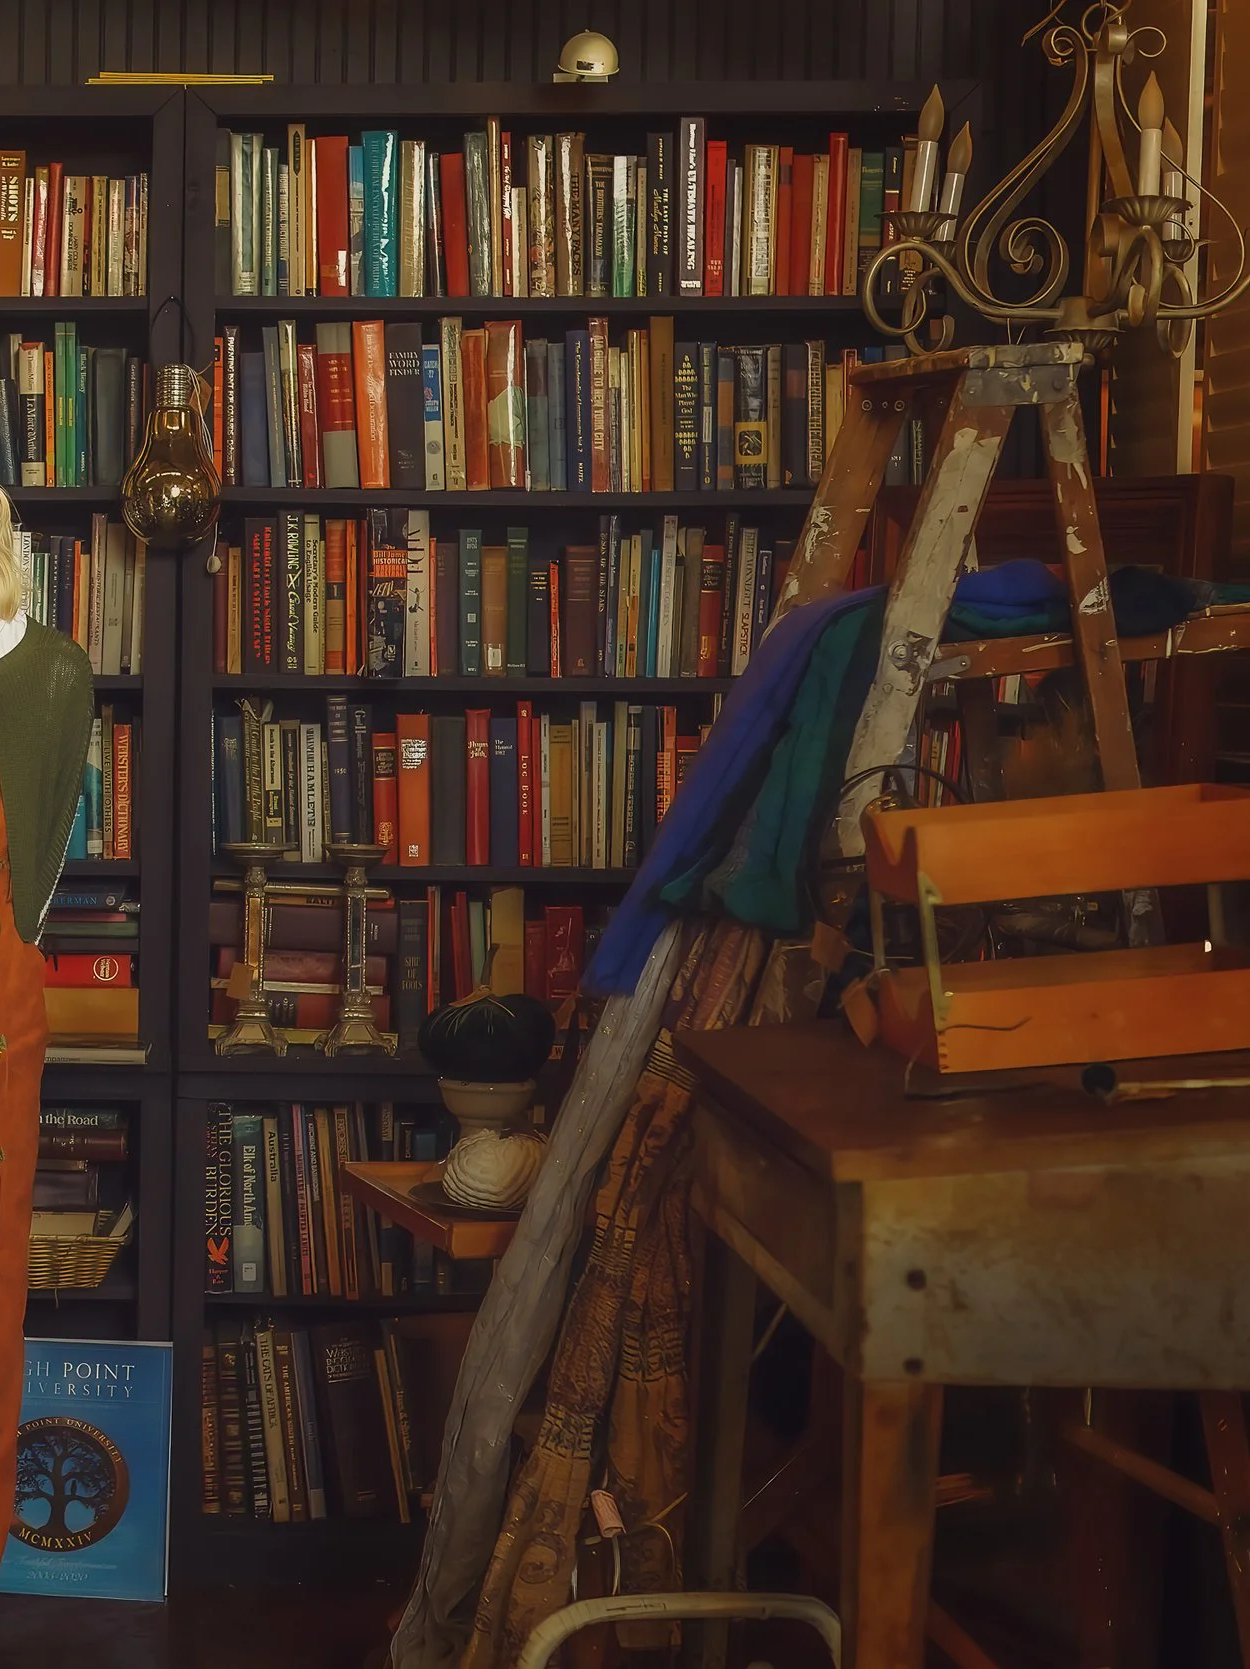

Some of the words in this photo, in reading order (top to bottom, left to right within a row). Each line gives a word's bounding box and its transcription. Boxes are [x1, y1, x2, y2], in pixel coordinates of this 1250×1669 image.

[388, 360, 420, 369] WORD
[389, 368, 420, 377] FINDER
[251, 776, 261, 796] Little
[117, 794, 129, 852] DICTIONARY
[46, 1113, 64, 1125] the
[68, 1114, 98, 1126] Road
[268, 1131, 278, 1182] Australia
[23, 1360, 50, 1377] GH
[63, 1362, 135, 1381] POINT
[25, 1381, 134, 1398] IVERSITY
[25, 1417, 60, 1432] POINT
[18, 1527, 93, 1550] MCMXXIV
